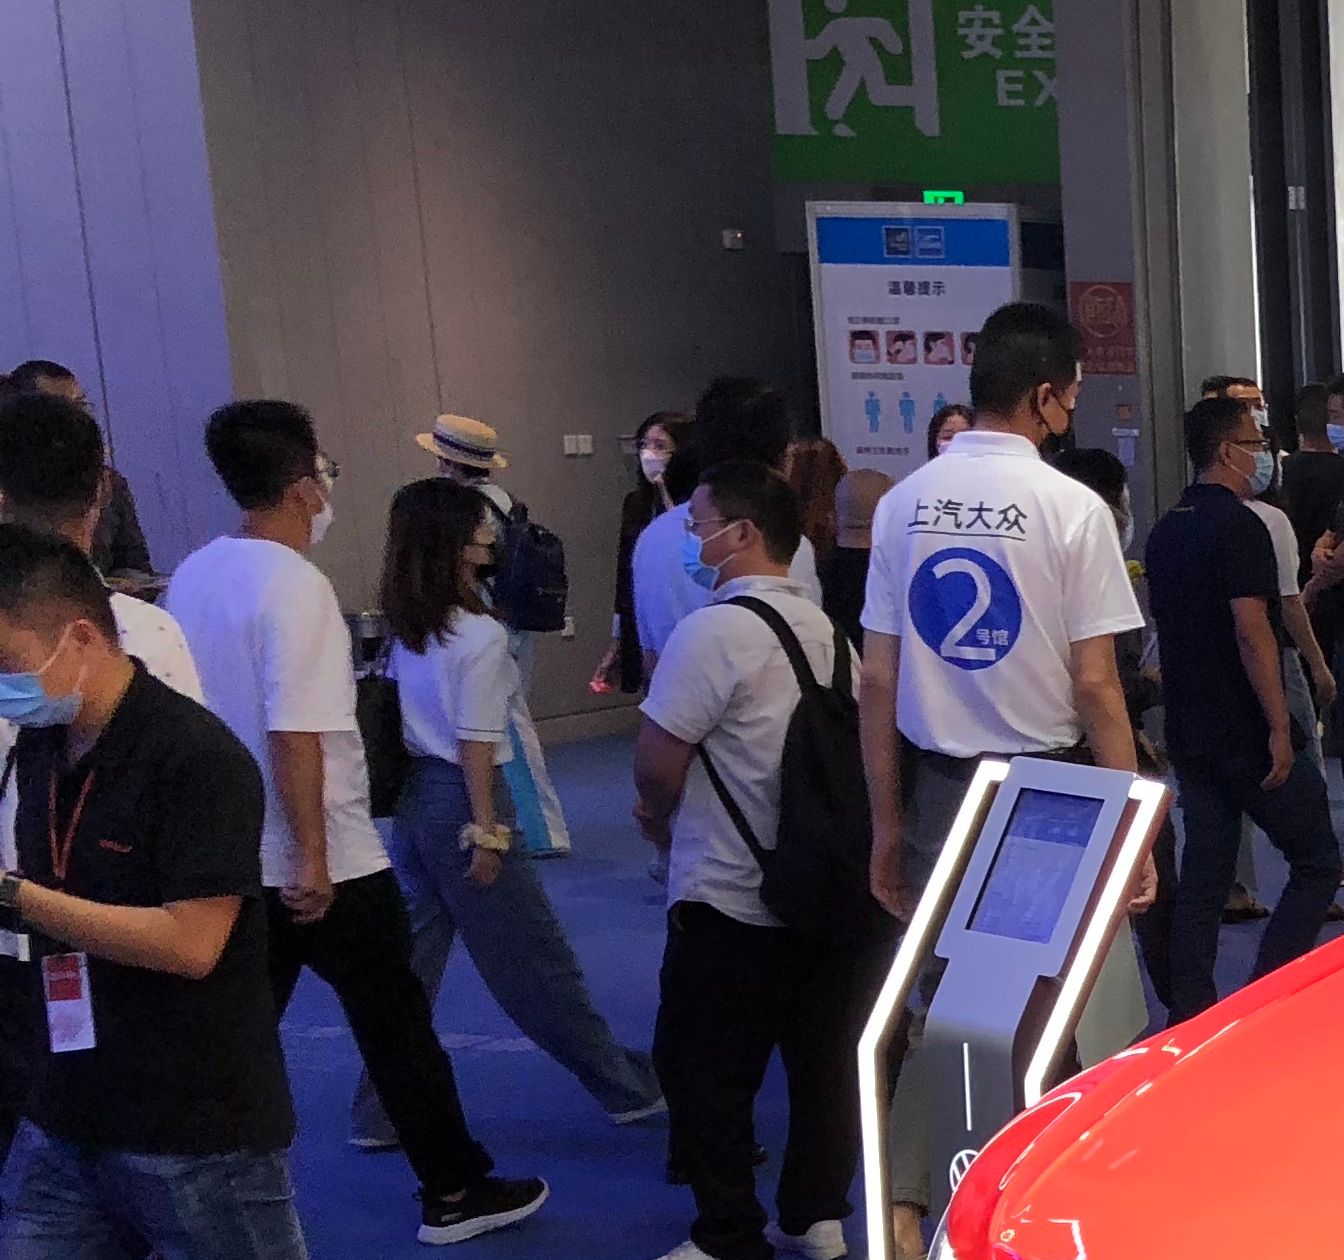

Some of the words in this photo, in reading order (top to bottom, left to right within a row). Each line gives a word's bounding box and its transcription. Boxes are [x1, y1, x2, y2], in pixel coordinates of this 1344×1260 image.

[957, 4, 1056, 59] 安全
[907, 499, 1028, 534] 上汽大众
[932, 558, 996, 661] 2
